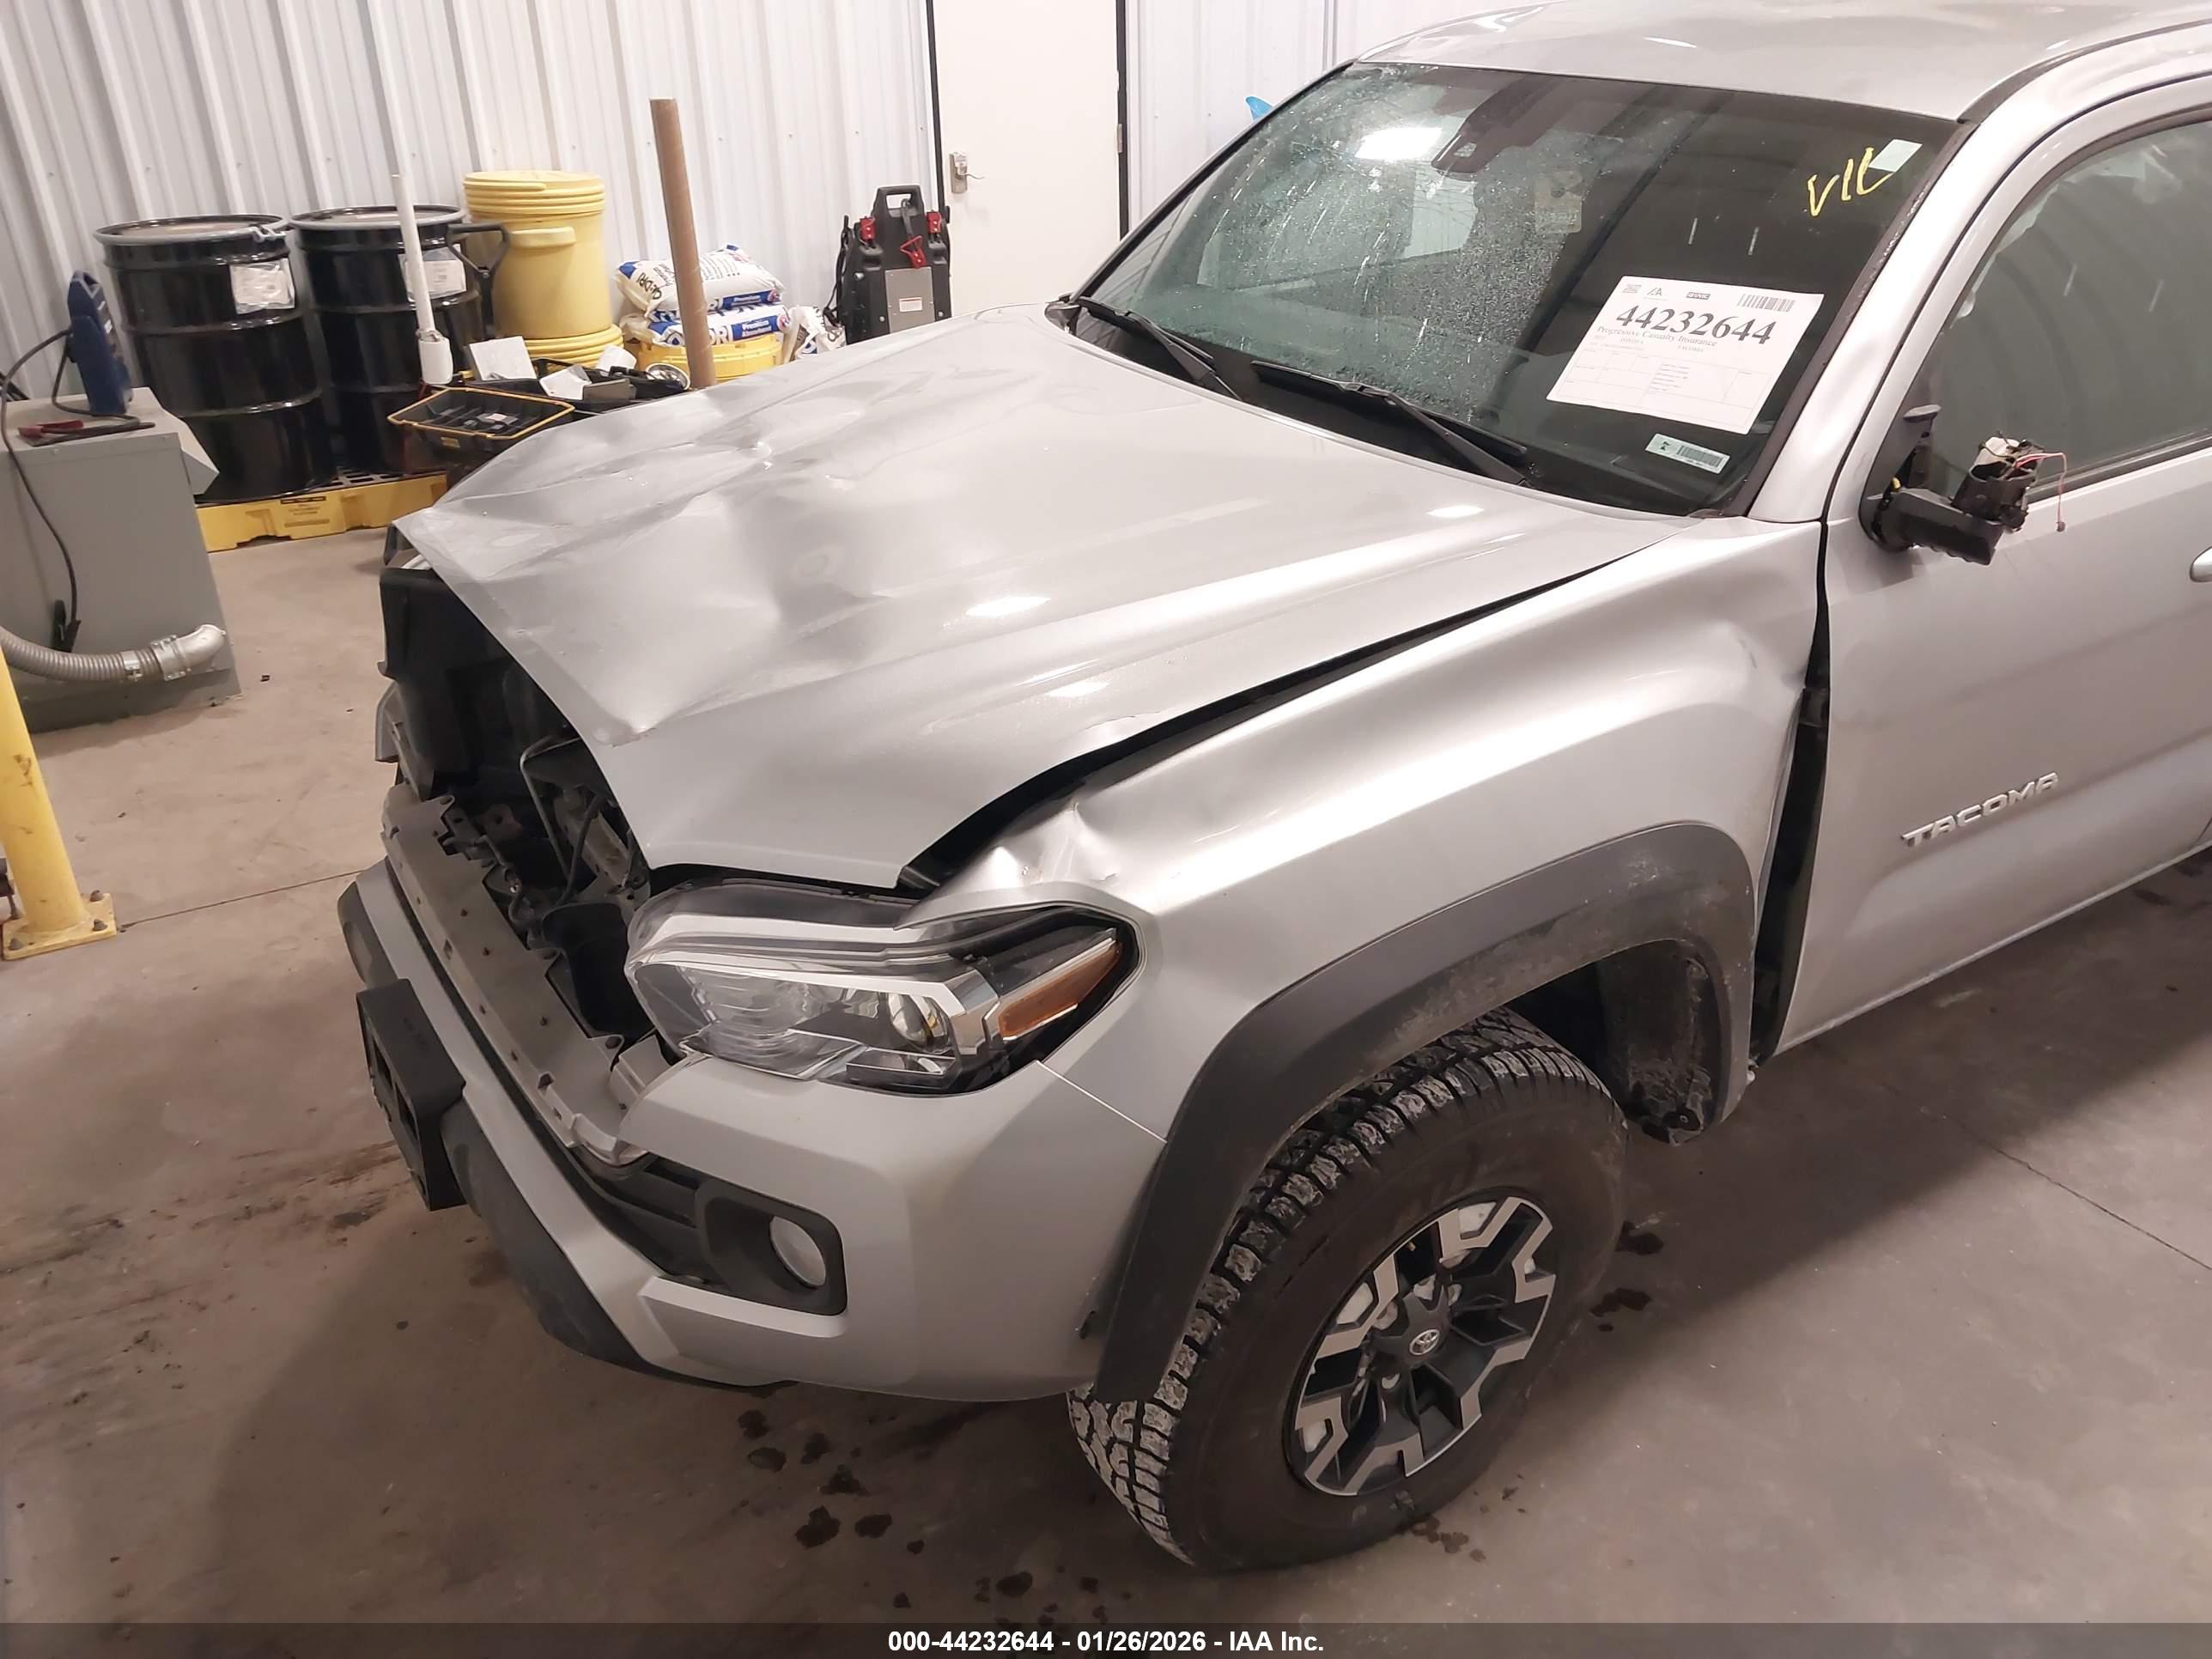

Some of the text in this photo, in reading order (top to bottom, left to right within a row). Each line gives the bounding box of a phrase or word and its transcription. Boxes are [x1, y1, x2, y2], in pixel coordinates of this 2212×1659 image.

[1597, 325, 1640, 337] Progressive
[1642, 331, 1675, 342] Casualty
[1678, 335, 1718, 347] Insurance
[1616, 305, 1777, 344] 44232644
[1900, 772, 2059, 847] TACOMA
